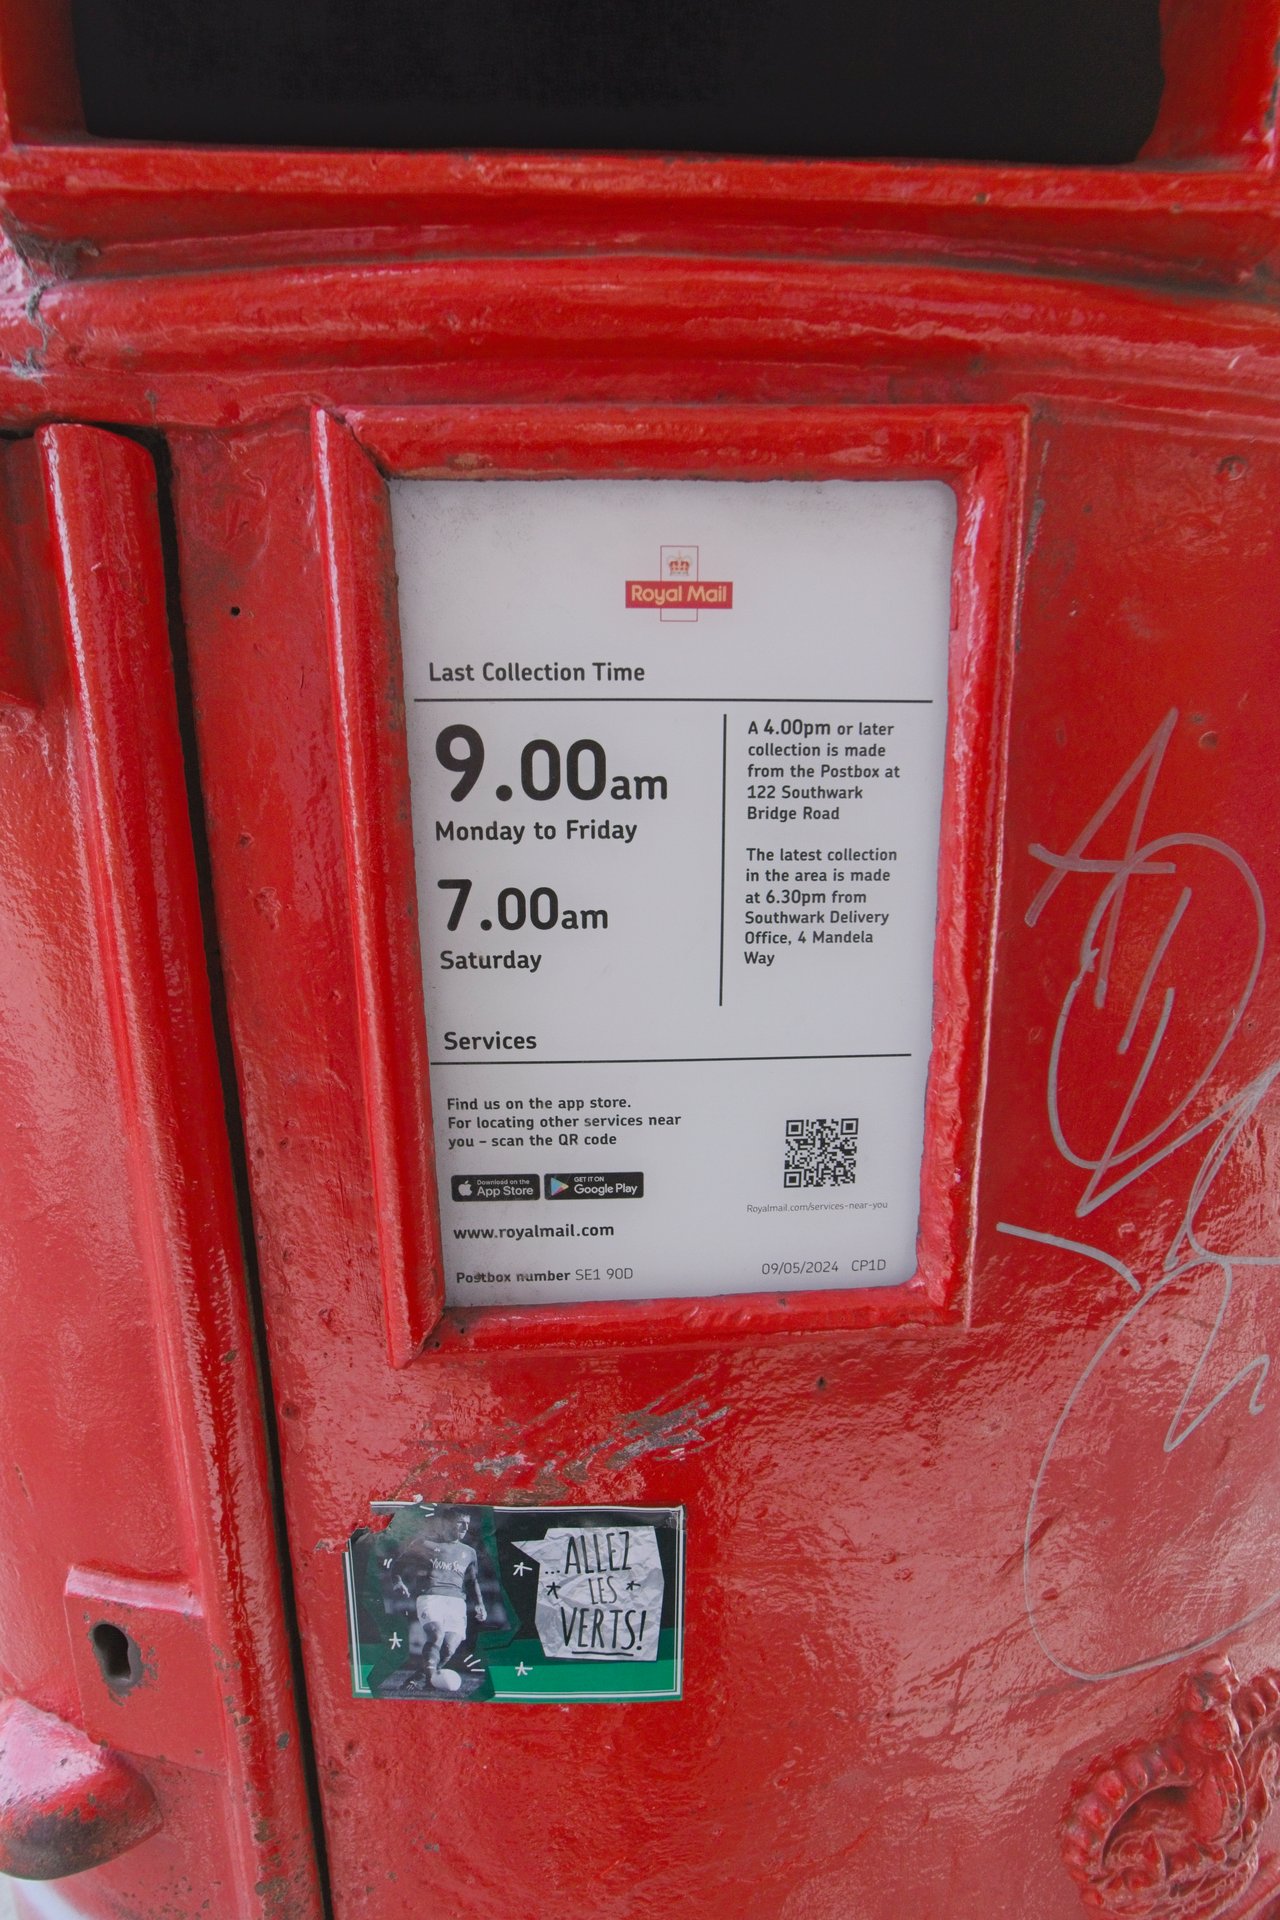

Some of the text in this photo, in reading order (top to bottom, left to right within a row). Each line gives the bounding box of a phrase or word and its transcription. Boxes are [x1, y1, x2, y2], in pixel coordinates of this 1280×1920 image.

[631, 585, 727, 605] Royal Mail
[429, 662, 645, 682] Last Collection Time
[748, 719, 894, 738] A 4.00pm or later
[748, 742, 886, 757] collection is made
[435, 724, 667, 802] 9.00am
[747, 764, 900, 778] from the Postbox at
[747, 785, 863, 799] 122 Southwark
[748, 806, 839, 823] Bridge Road
[435, 819, 637, 845] Monday to Friday
[746, 848, 897, 861] The latest collection
[746, 868, 890, 882] in the area is made
[437, 879, 608, 932] 7.00am
[745, 889, 866, 907] at 6.30pm from
[745, 910, 889, 926] Southwark Delivery
[745, 930, 873, 945] Office, 4 Mandela
[440, 950, 542, 973] Saturday
[744, 951, 775, 967] Way
[444, 1031, 537, 1050] Services
[447, 1097, 631, 1111] Find us on the app store.
[448, 1114, 681, 1130] For locating other services near
[448, 1138, 474, 1150] you
[491, 1137, 524, 1147] scan
[529, 1134, 553, 1146] the
[559, 1133, 578, 1146] QR
[584, 1133, 617, 1145] code
[477, 1185, 534, 1198] App Store
[574, 1183, 638, 1196] Google Play
[747, 1202, 888, 1214] Royalmail.com/services-near-you
[452, 1224, 614, 1241] www.royalmail.com
[762, 1259, 886, 1275] 09/05/2024 CP1D
[456, 1272, 511, 1284] Postbox
[516, 1270, 571, 1282] number
[575, 1269, 600, 1281] SE1
[589, 1577, 618, 1605] LES
[560, 1607, 647, 1651] VERTS!
